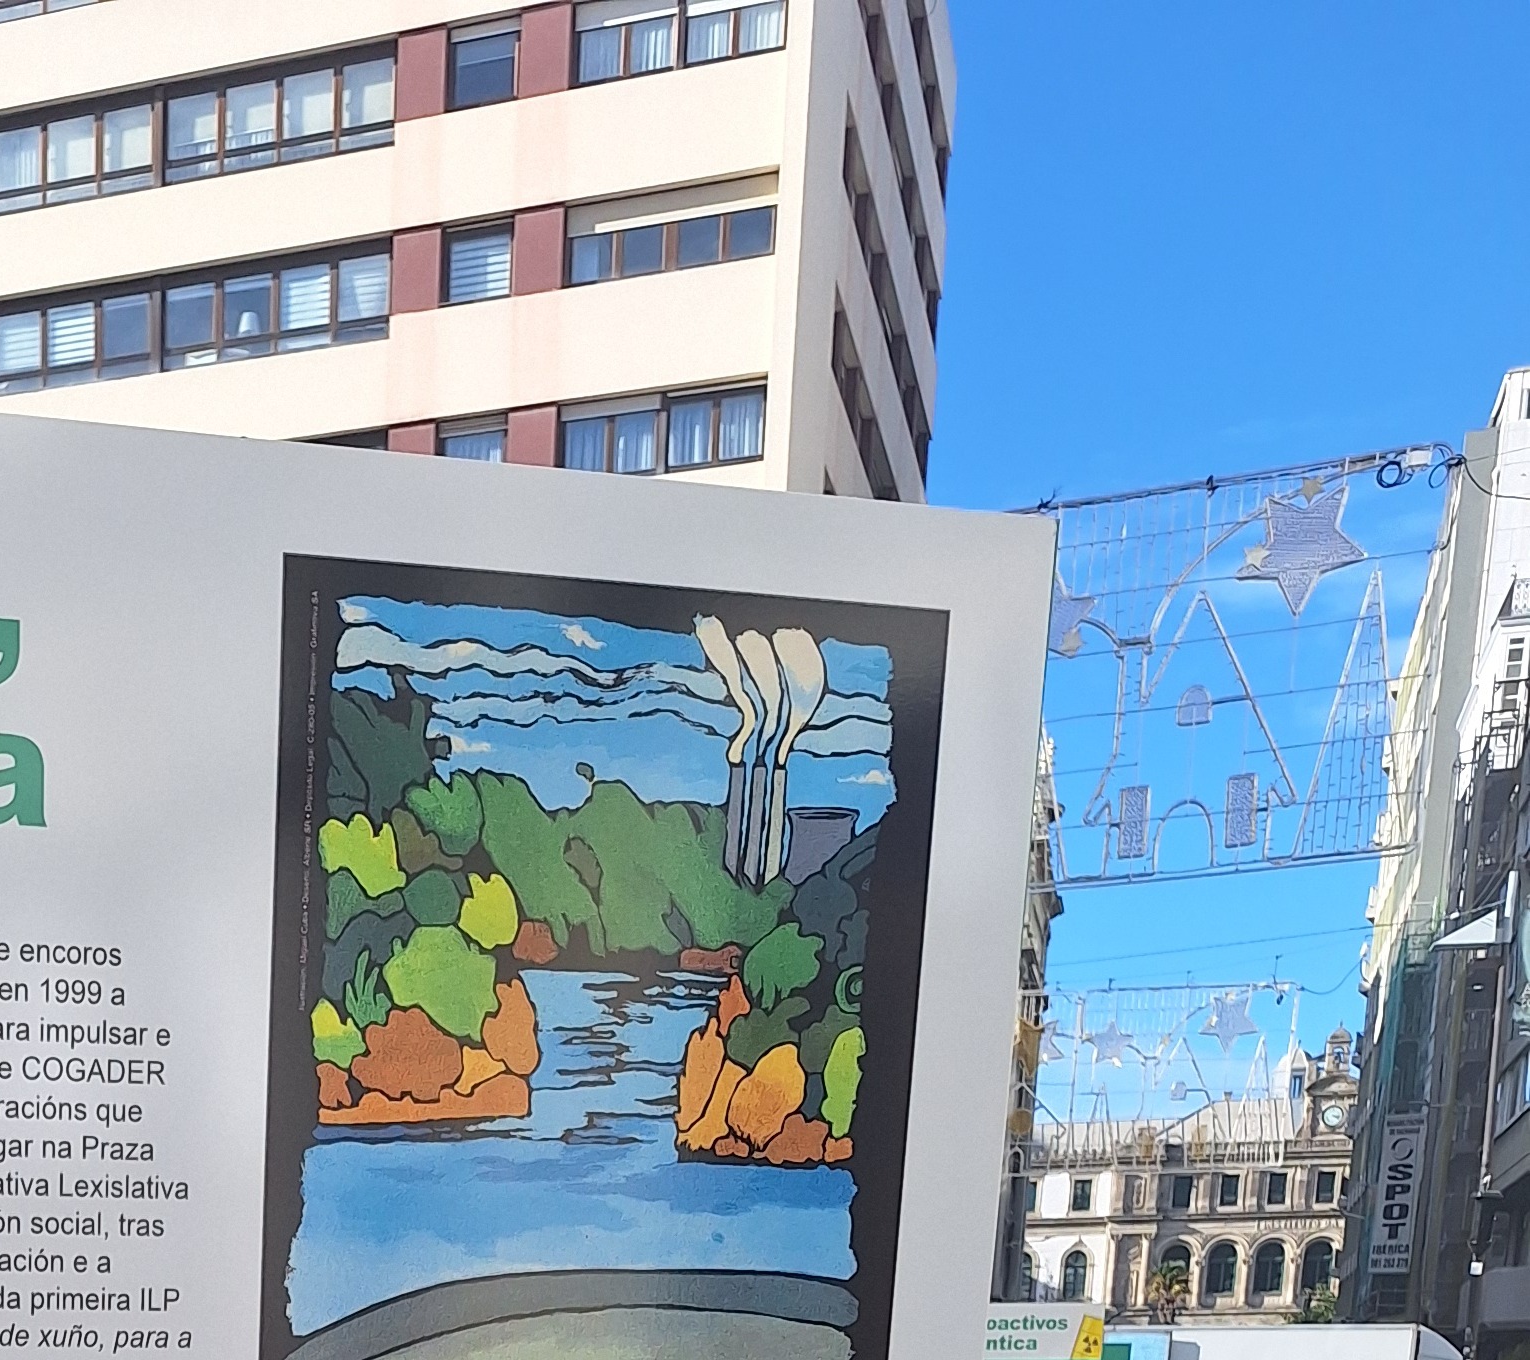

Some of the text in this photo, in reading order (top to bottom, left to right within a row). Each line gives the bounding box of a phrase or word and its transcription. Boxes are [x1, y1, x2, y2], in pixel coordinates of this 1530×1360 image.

[19, 943, 122, 967] encoros
[40, 978, 102, 1005] 1999
[110, 987, 125, 1006] a
[1382, 1163, 1414, 1240] SPOT
